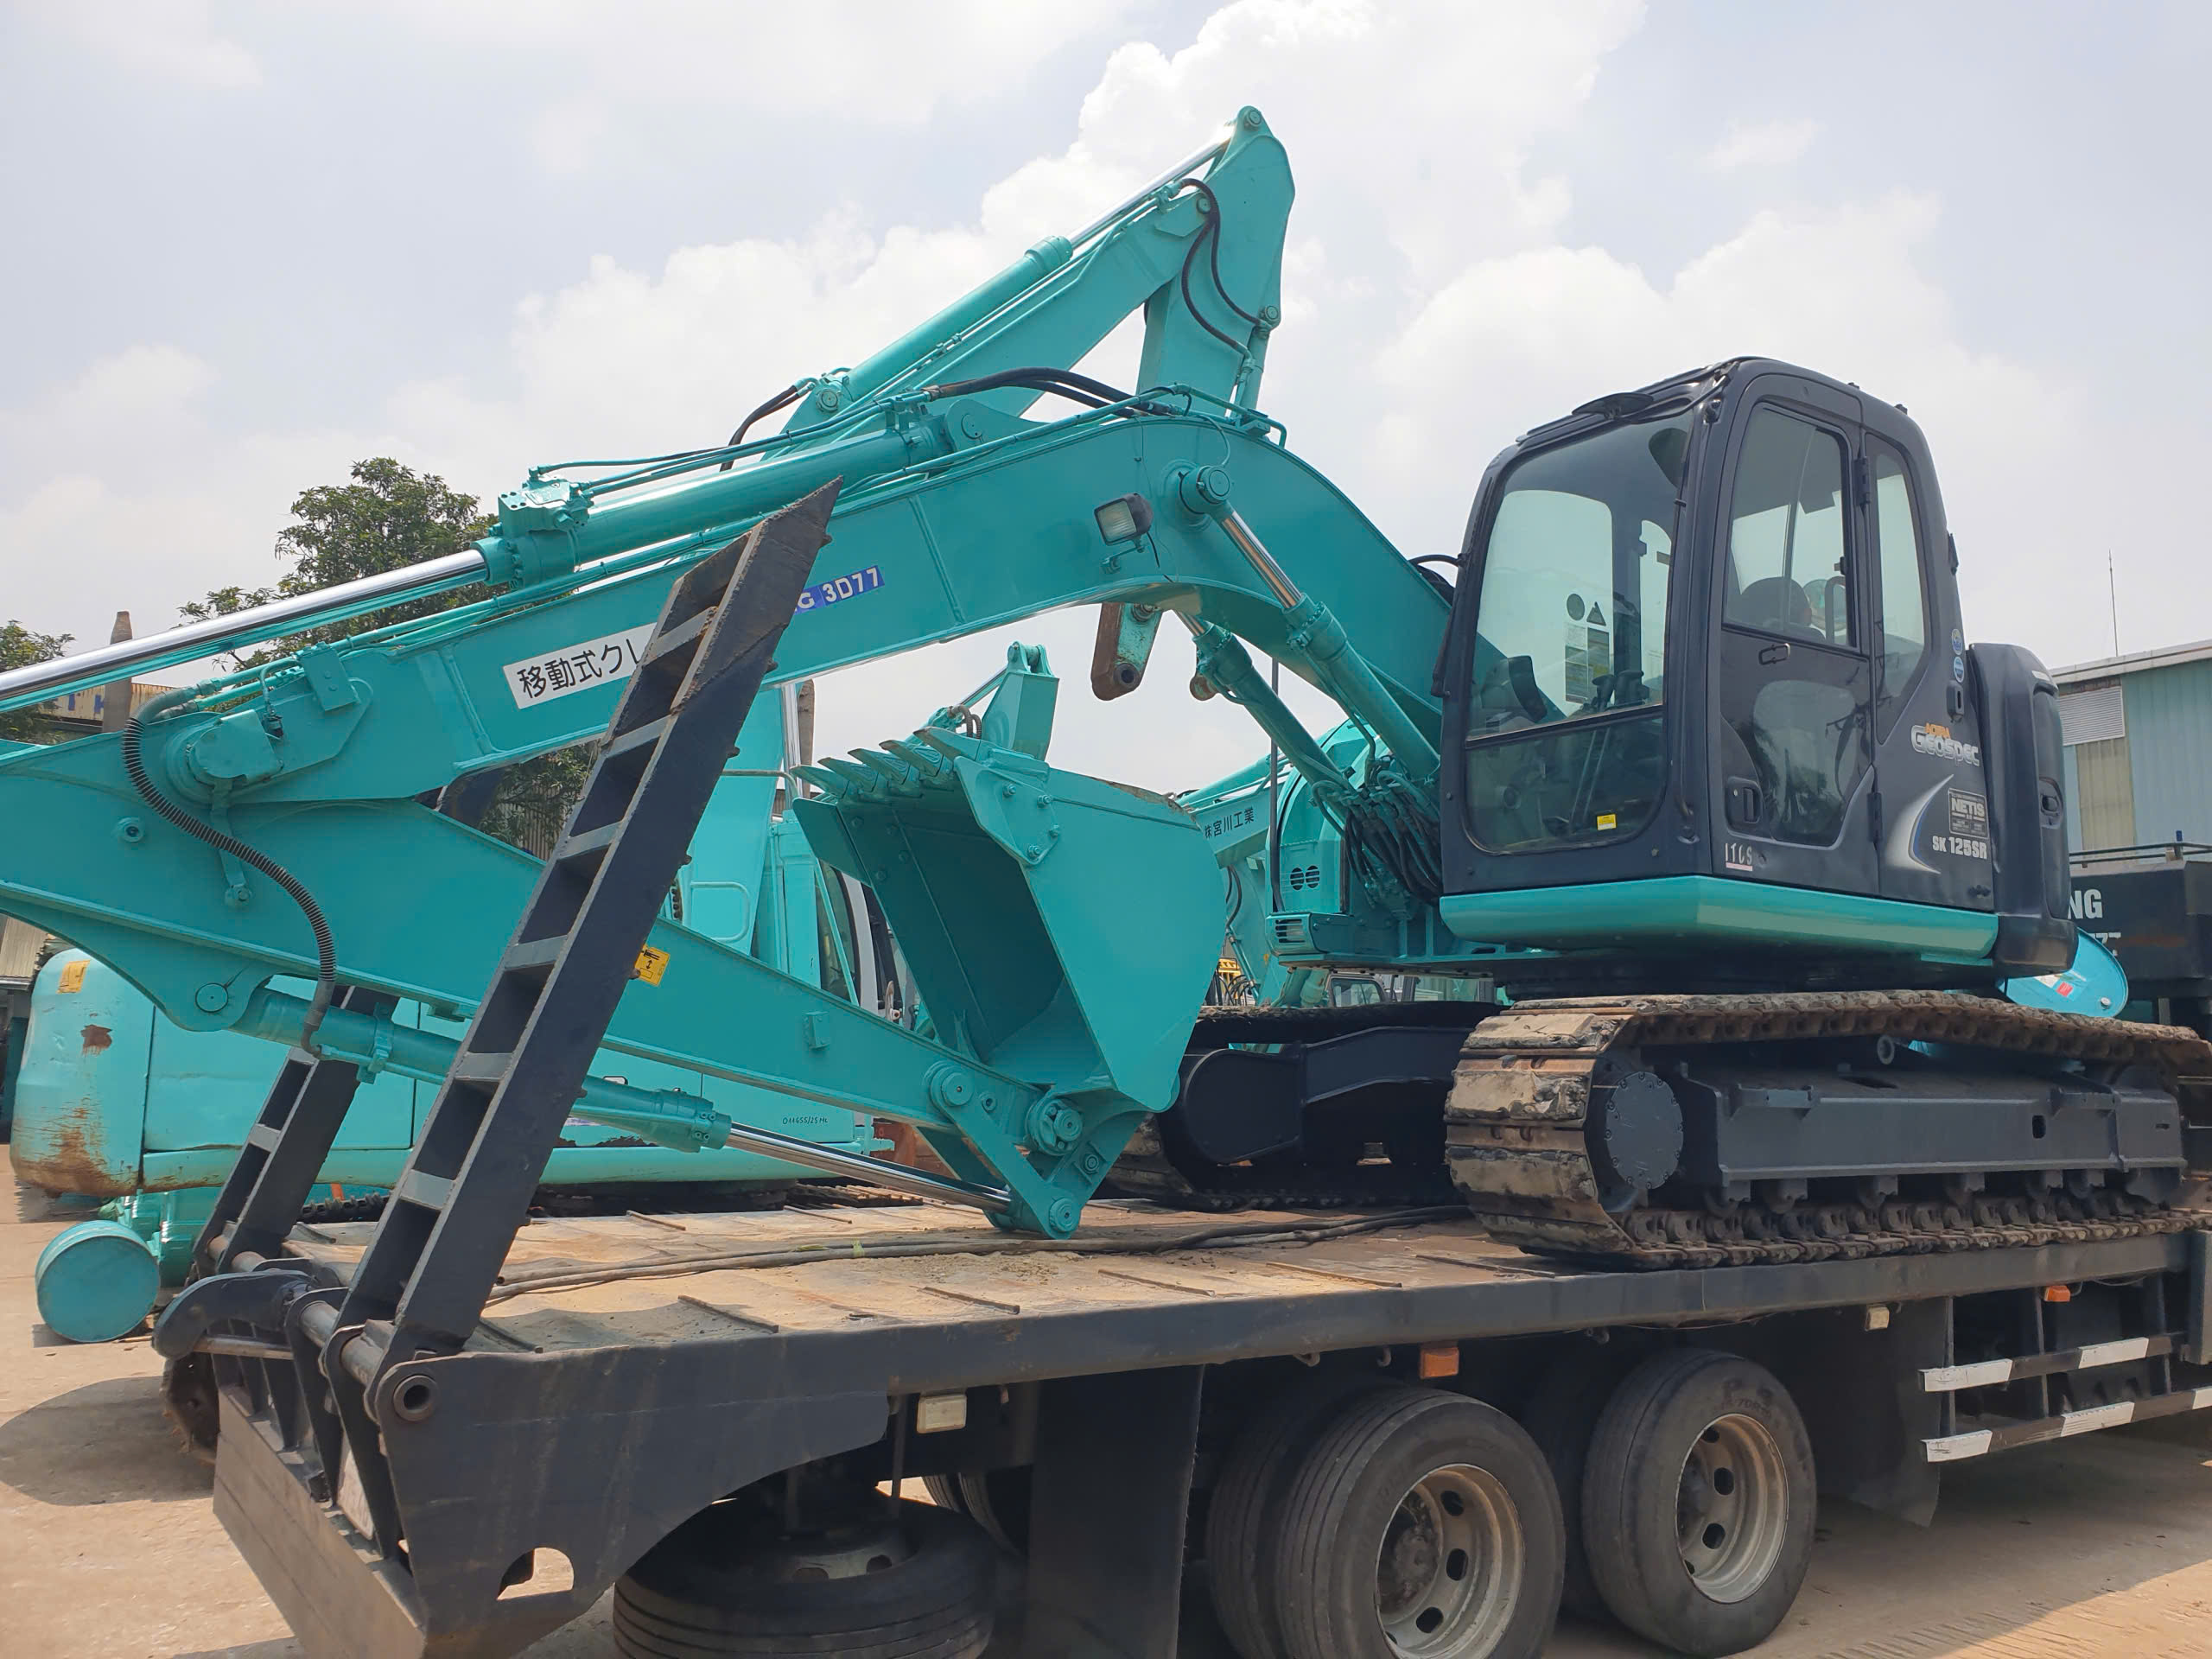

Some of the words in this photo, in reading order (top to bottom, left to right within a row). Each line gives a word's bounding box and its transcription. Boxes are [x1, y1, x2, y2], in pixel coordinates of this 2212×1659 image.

[823, 568, 879, 602] 3D77
[1951, 798, 1985, 817] NETIS
[1932, 836, 1947, 852] SK
[1948, 836, 1987, 859] 125SR
